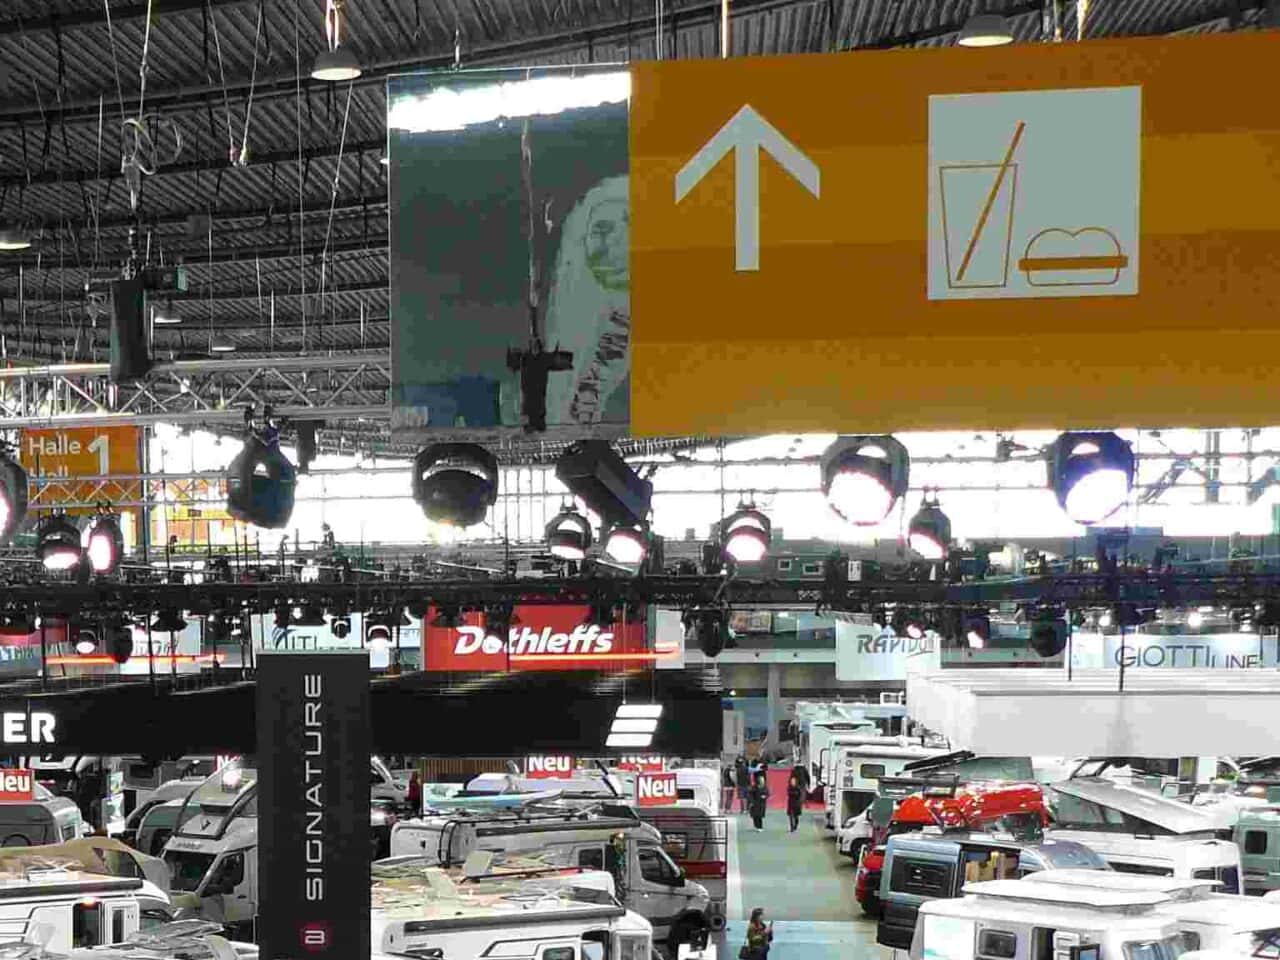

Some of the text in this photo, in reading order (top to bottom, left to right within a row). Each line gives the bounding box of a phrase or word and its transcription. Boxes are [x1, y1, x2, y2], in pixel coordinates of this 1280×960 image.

[28, 434, 110, 478] Halle 1
[528, 753, 571, 772] Neu
[304, 673, 324, 901] SIGNATURE
[638, 776, 677, 798] Neu
